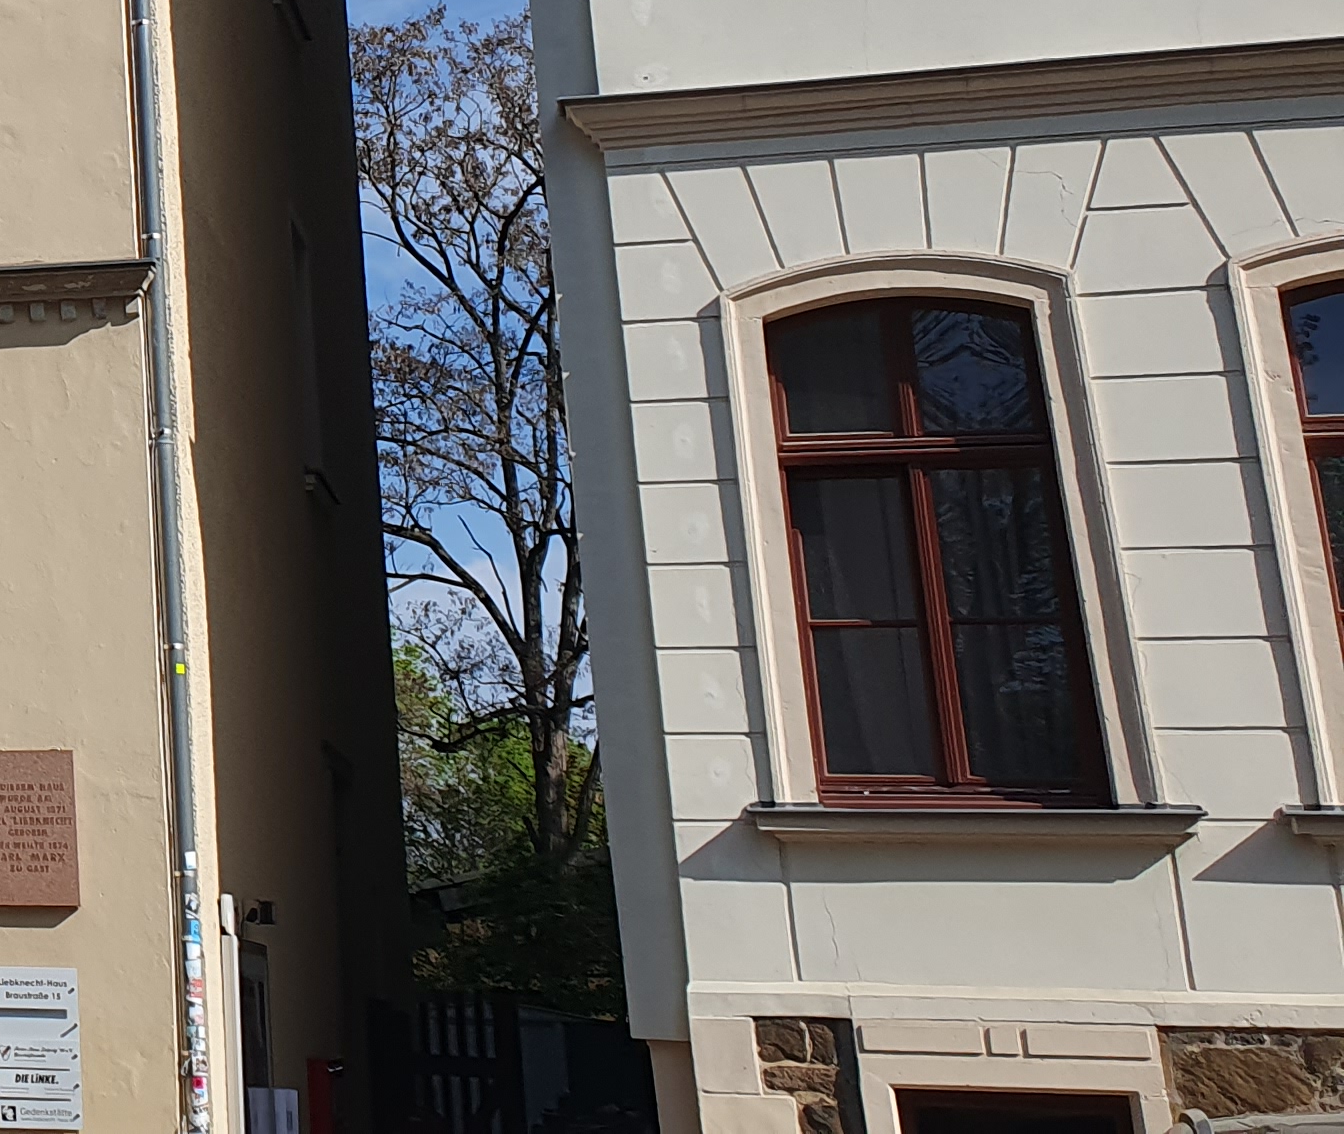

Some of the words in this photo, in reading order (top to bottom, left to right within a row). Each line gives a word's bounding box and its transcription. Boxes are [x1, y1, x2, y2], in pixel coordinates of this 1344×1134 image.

[0, 783, 35, 792] DIESEM
[0, 794, 33, 803] WURDE
[4, 805, 41, 814] AUGUST
[46, 805, 66, 814] 1871
[13, 816, 73, 826] LIEBKNECHT
[7, 828, 49, 837] GEBOREN
[30, 852, 66, 862] MARX
[9, 864, 23, 873] ZU
[26, 864, 50, 873] GAST
[5, 991, 49, 1000] Braustraße
[52, 992, 61, 1000] 15
[15, 1073, 29, 1084] DIE
